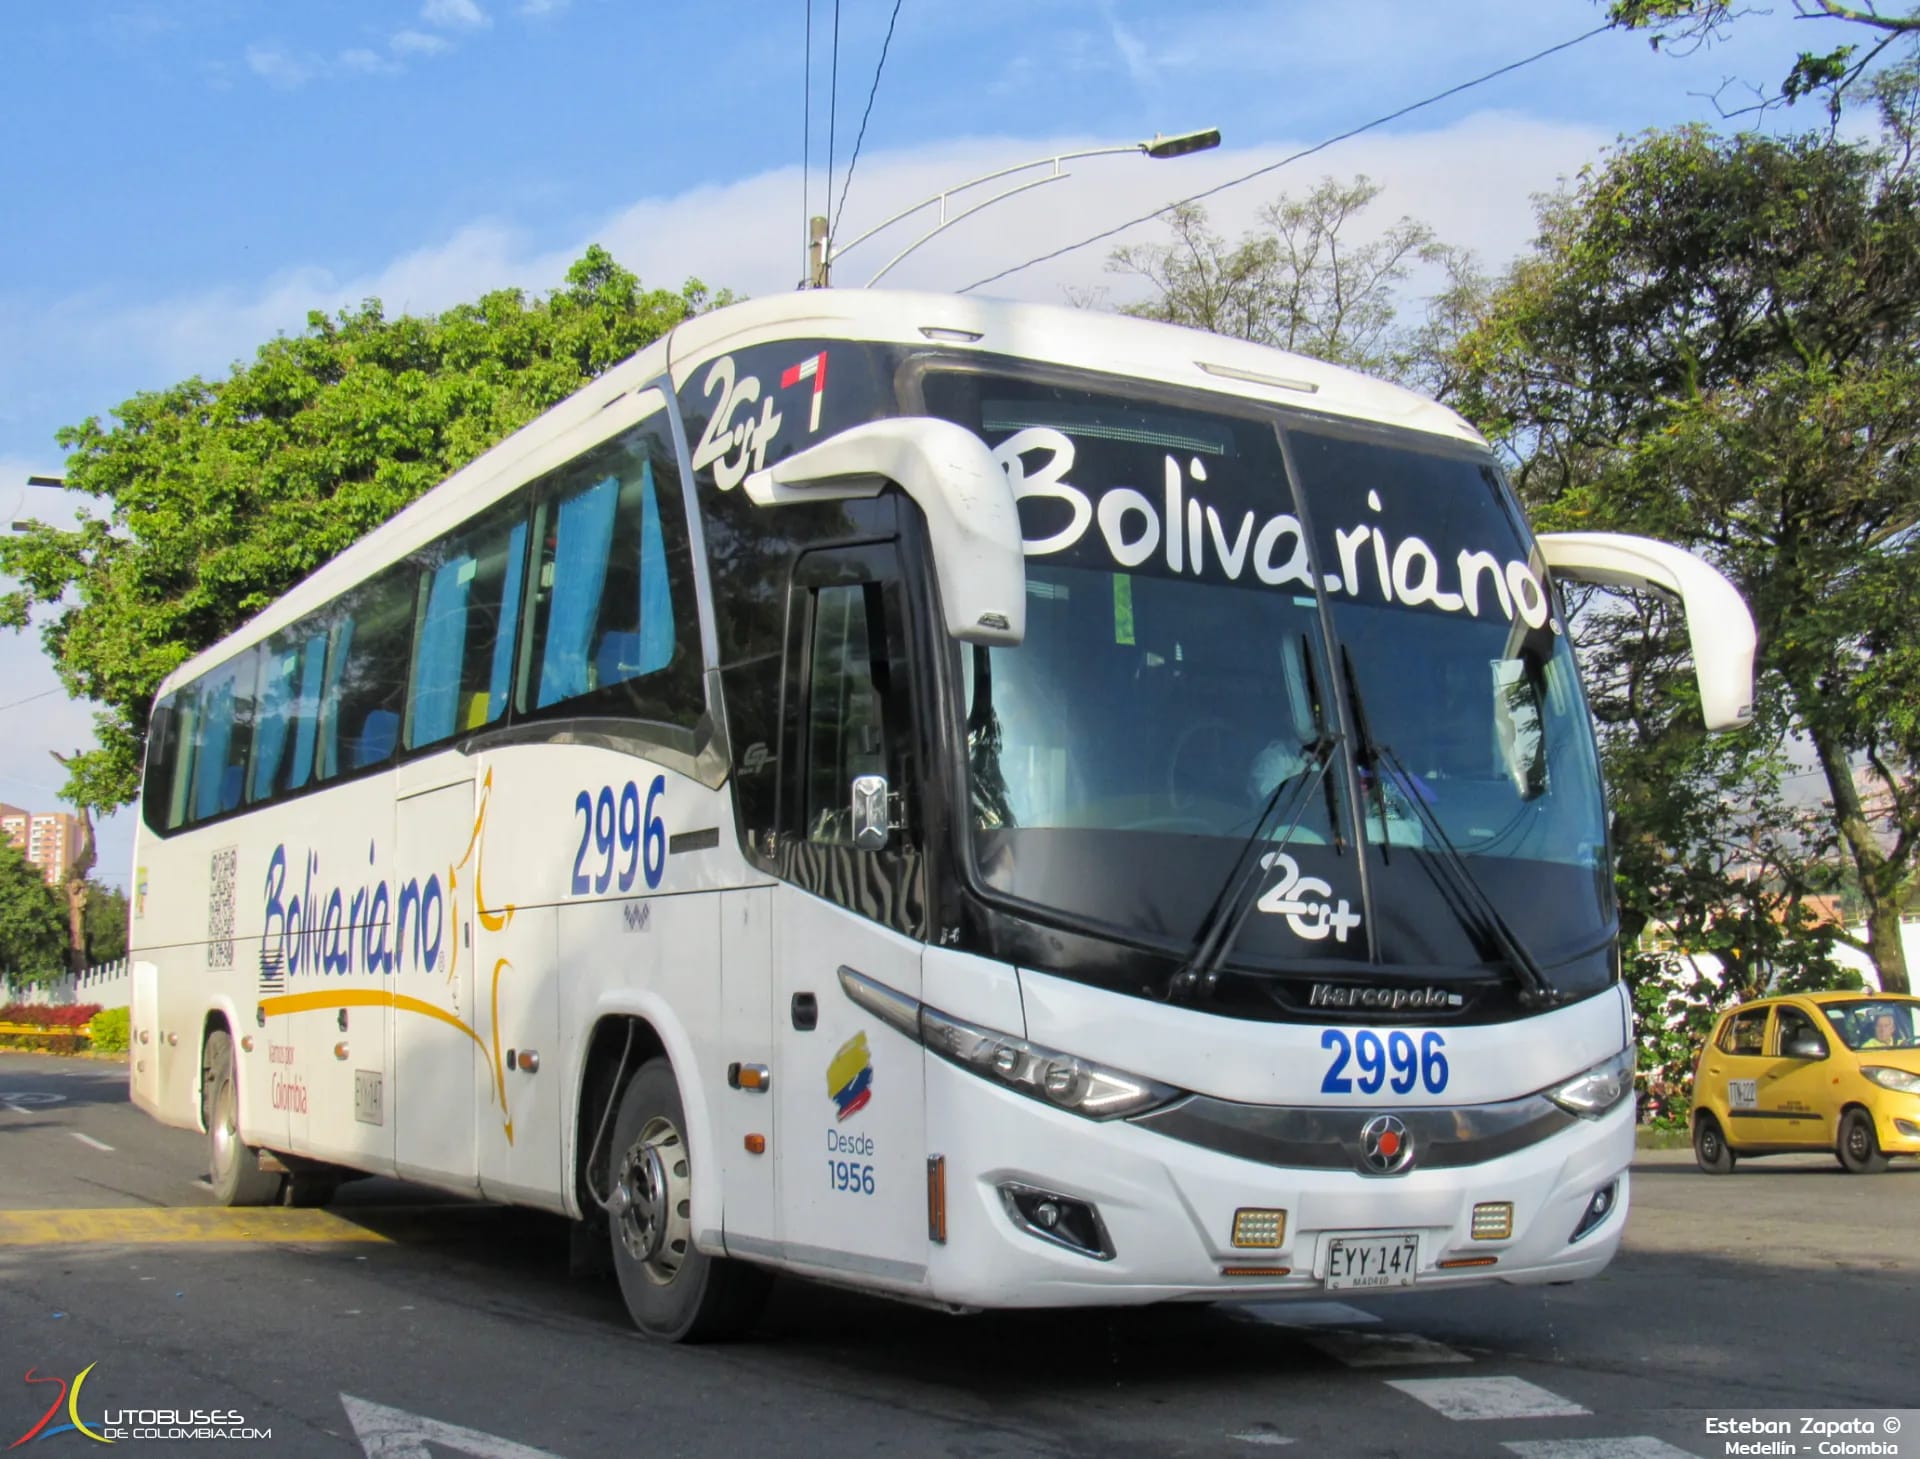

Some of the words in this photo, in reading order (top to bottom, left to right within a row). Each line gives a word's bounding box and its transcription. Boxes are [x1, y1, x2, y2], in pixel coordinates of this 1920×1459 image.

[990, 427, 1548, 629] Bolivariano
[571, 774, 665, 896] 2996
[262, 837, 443, 980] Bolivariano
[1309, 984, 1448, 1009] Marcopolo
[1320, 1029, 1449, 1095] 2996
[827, 1129, 875, 1157] Desde
[828, 1160, 875, 1196] 1956
[1353, 1276, 1389, 1287] MADRID
